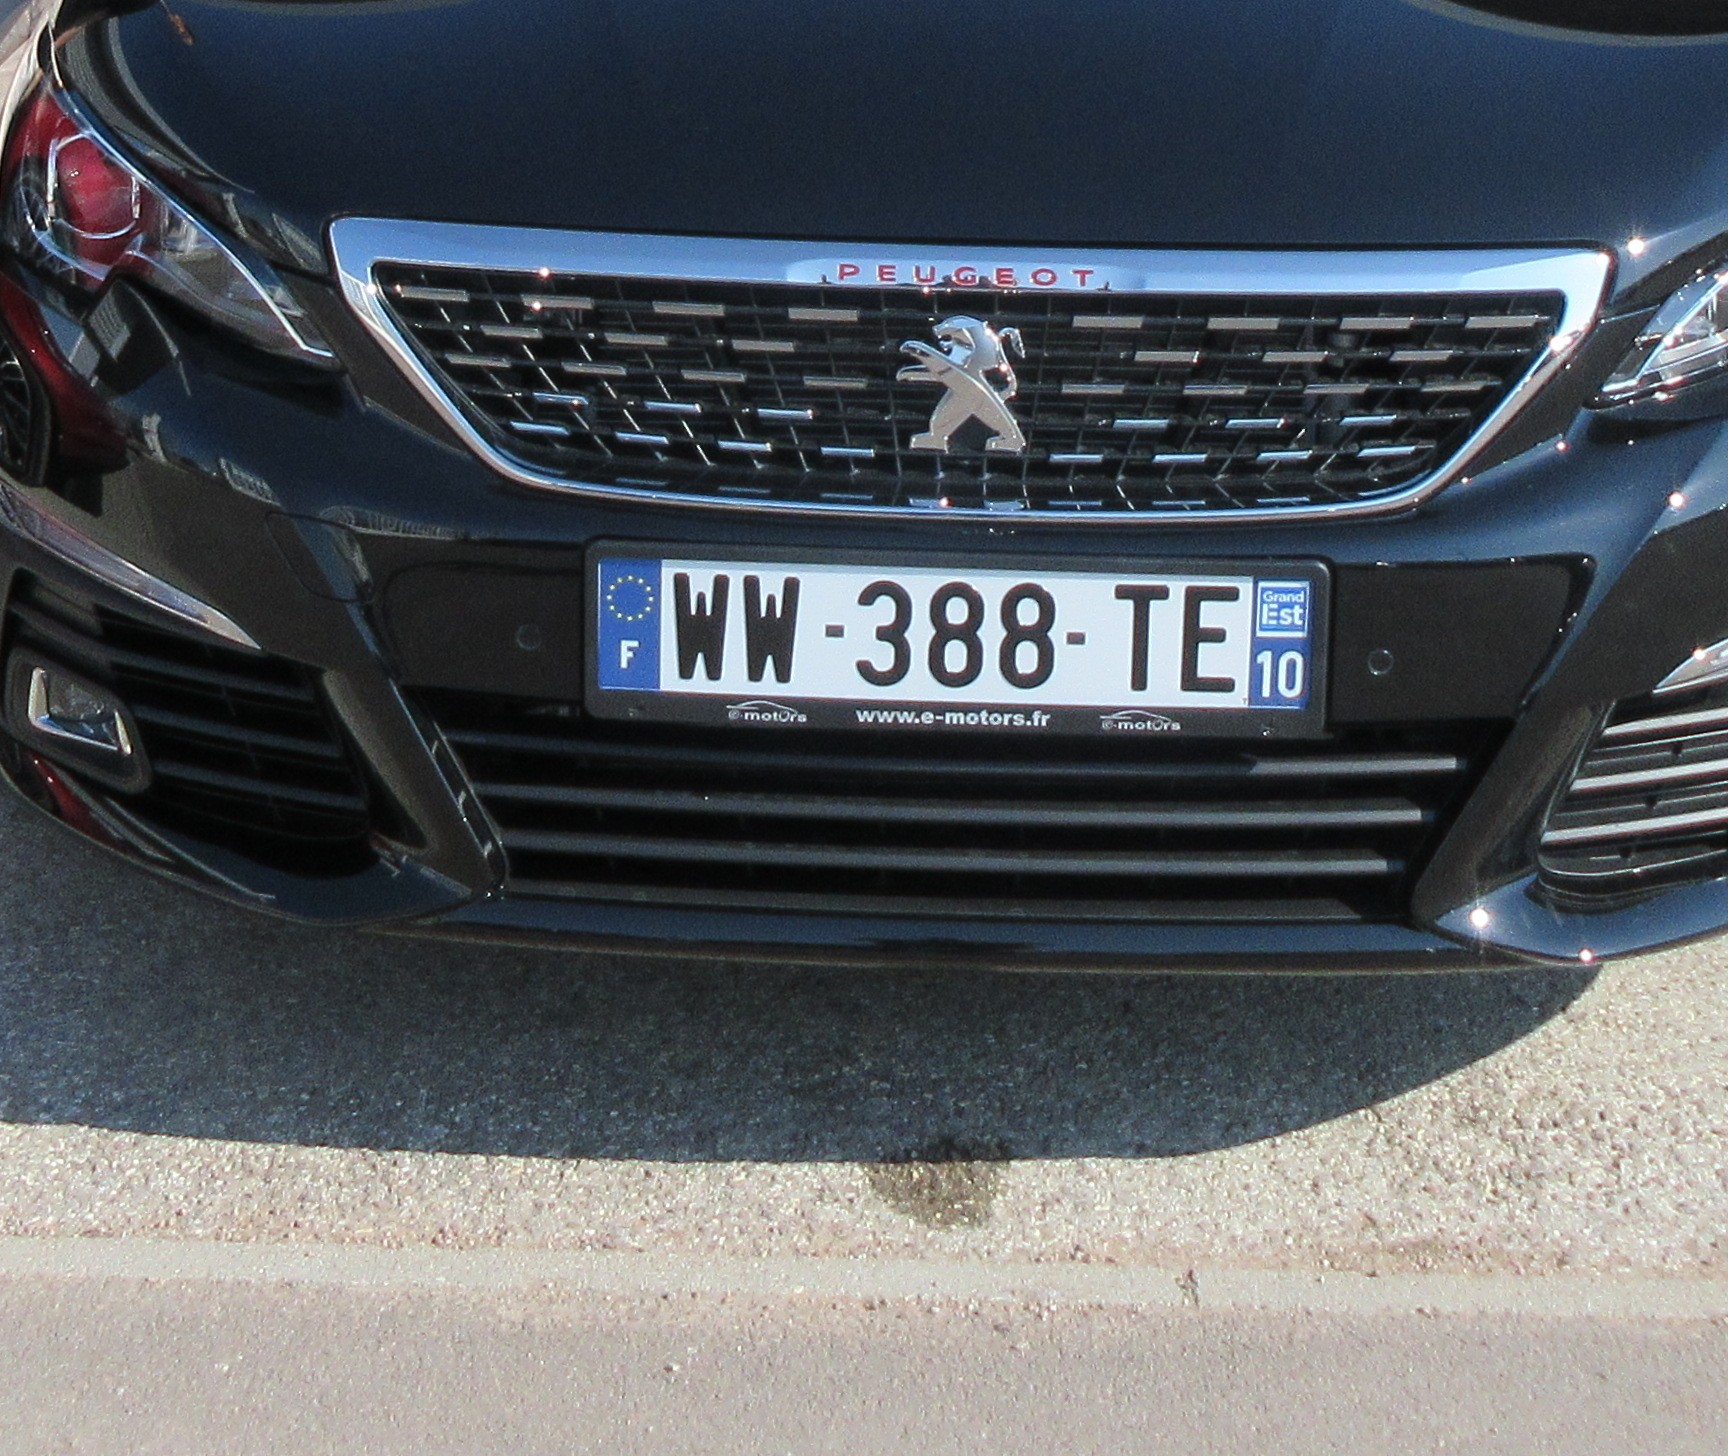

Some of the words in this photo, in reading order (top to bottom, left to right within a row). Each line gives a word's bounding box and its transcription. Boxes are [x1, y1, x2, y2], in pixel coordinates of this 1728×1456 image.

[836, 262, 1095, 288] PEUGEOT
[1262, 589, 1305, 603] Grand
[1261, 604, 1304, 626] Est
[620, 639, 640, 669] F
[1256, 649, 1304, 699] 10
[855, 708, 1051, 727] www.e-motors.fr
